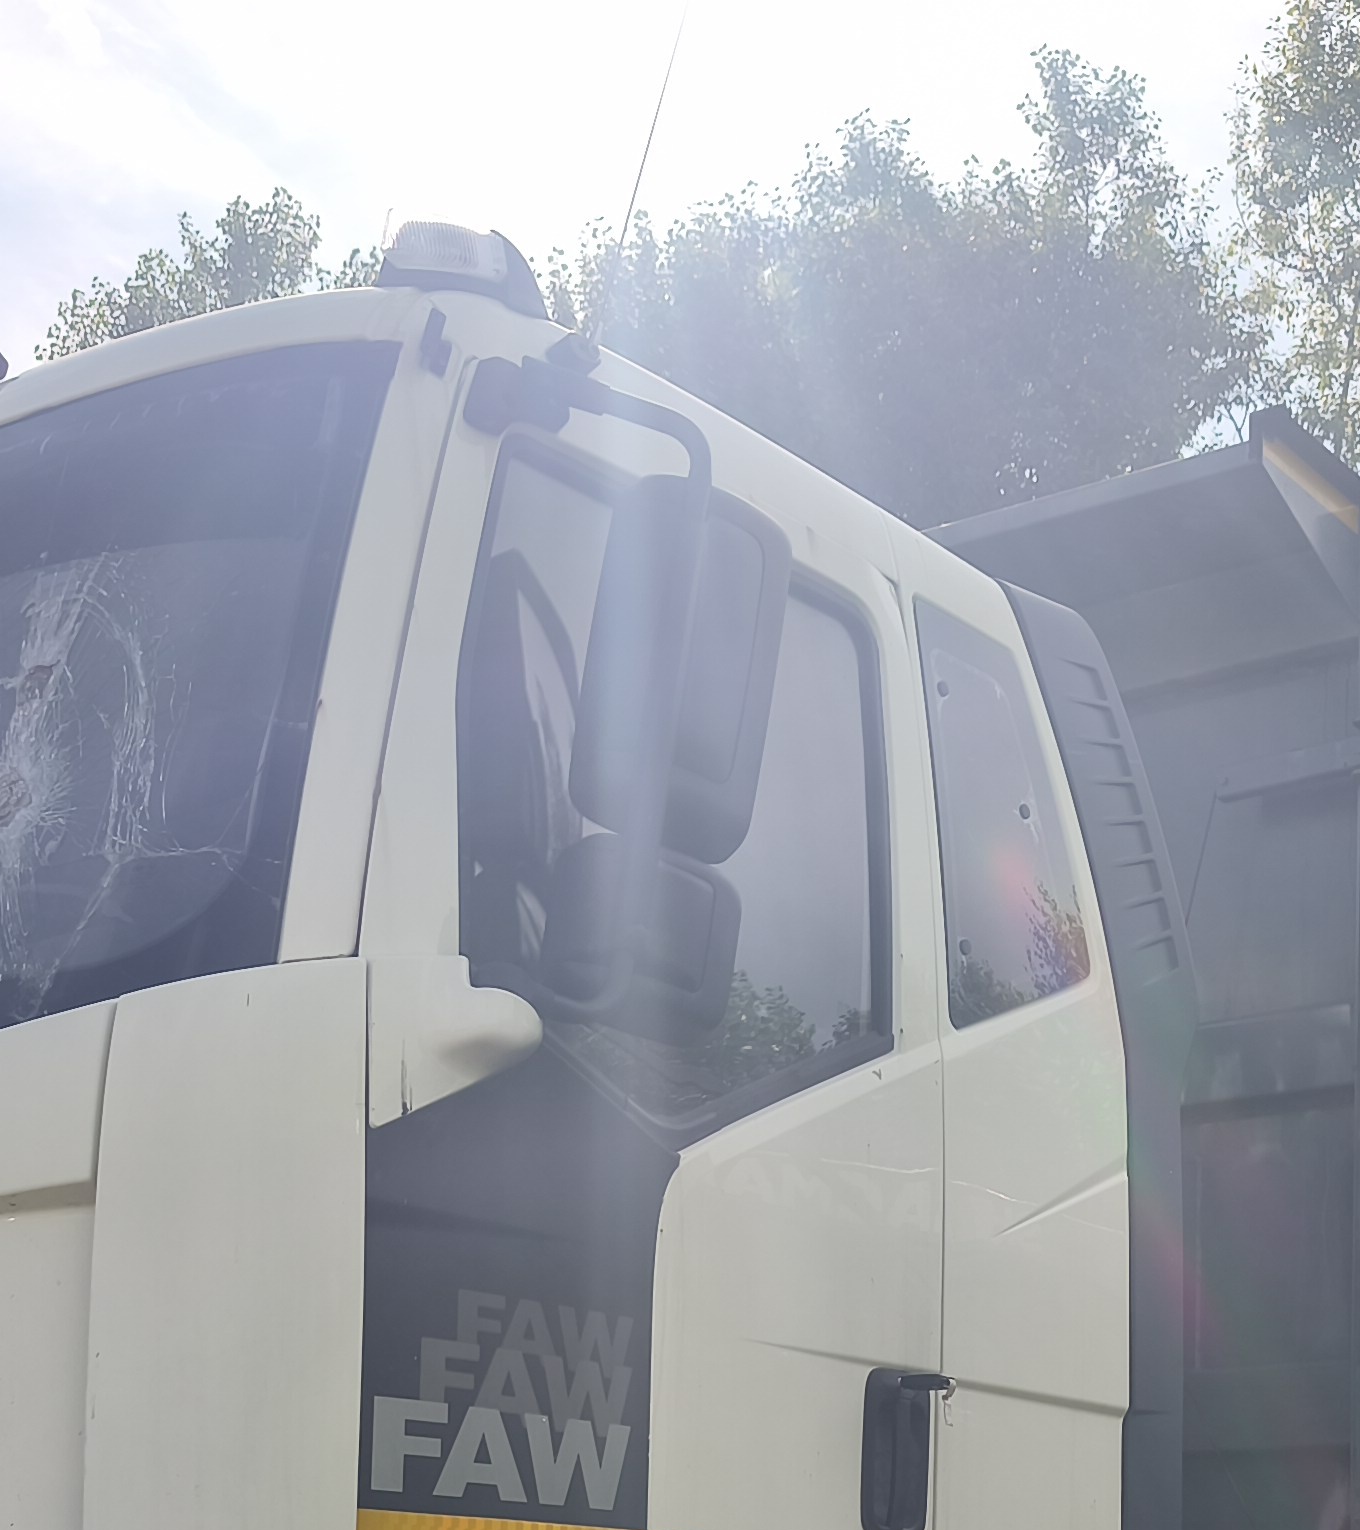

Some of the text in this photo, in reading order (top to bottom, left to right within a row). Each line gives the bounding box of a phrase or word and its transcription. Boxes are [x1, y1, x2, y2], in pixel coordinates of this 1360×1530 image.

[456, 1289, 635, 1379] FAW
[419, 1337, 634, 1437] FAW
[370, 1395, 632, 1511] FAW
